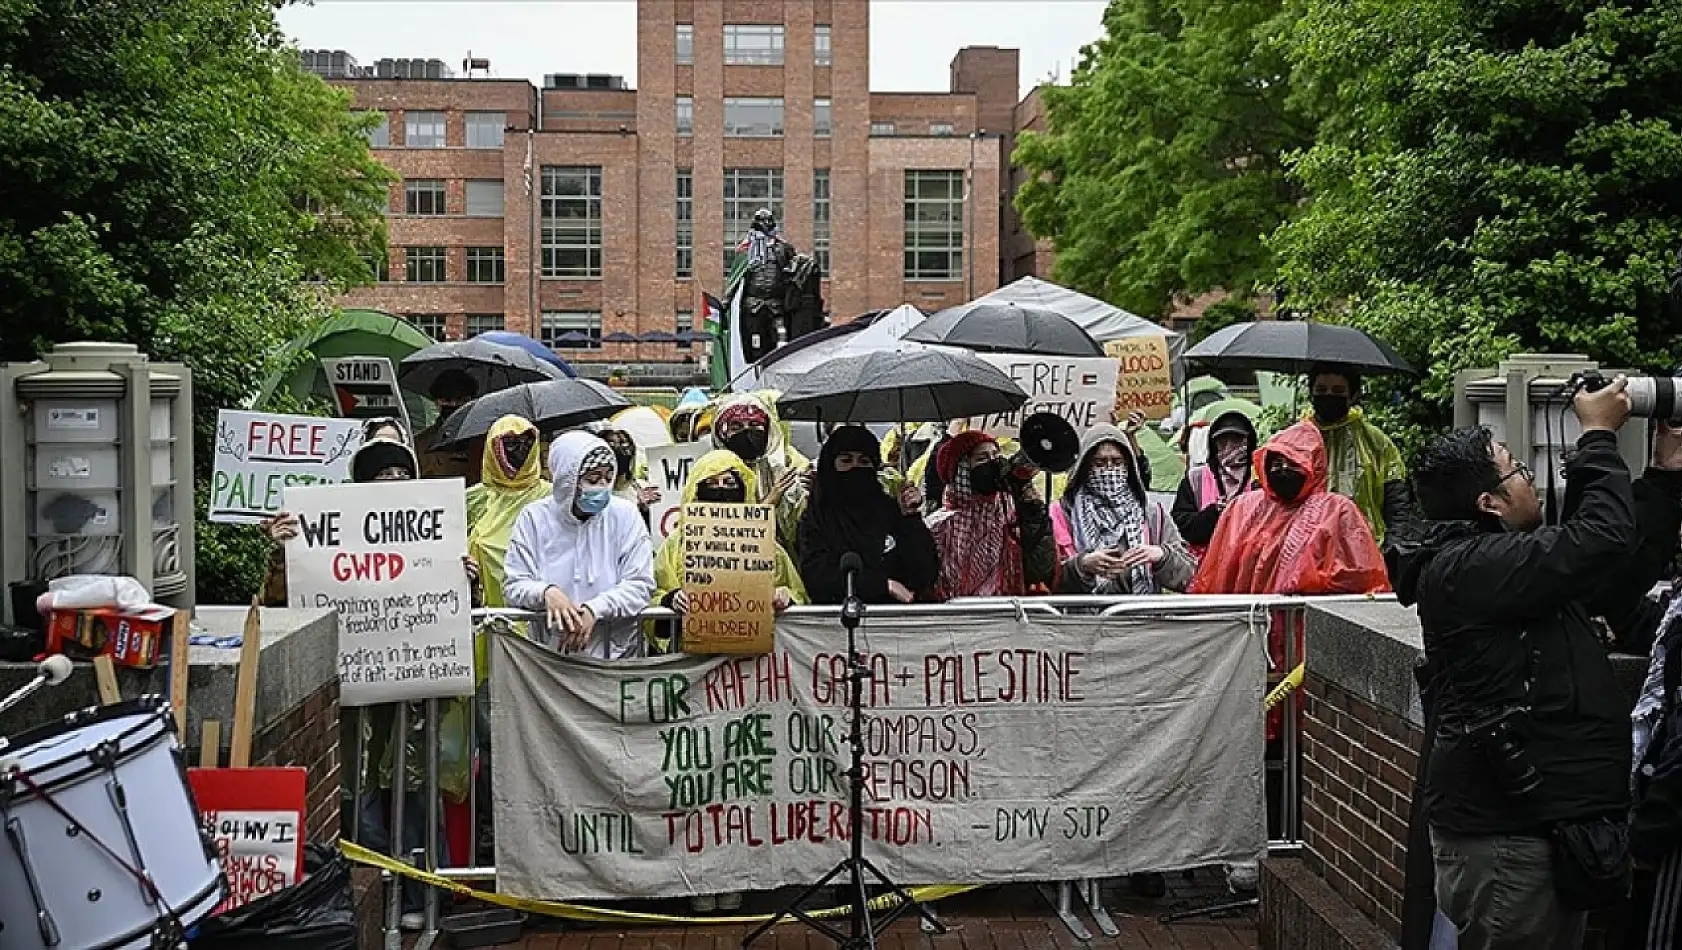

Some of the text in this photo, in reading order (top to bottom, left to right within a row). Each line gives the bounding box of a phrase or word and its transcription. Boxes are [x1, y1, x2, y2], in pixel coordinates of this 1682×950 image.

[336, 362, 381, 381] STAND
[1119, 354, 1164, 374] LOOD
[1010, 362, 1076, 397] FREE
[248, 421, 328, 457] FREE
[687, 506, 773, 521] WE WILL NOT
[299, 508, 445, 548] WE CHARGE
[685, 524, 768, 539] SIT SILENTLY
[685, 540, 700, 552] BY
[332, 552, 405, 582] GWPD
[685, 555, 740, 570] STUDENT
[687, 590, 765, 614] BOMBS ON
[686, 616, 760, 637] CHILDREN
[619, 673, 691, 724] FOR
[812, 651, 890, 707] GAA
[924, 648, 1086, 707] PALESTINE
[659, 726, 713, 772] YOU
[722, 713, 776, 760] ARE
[787, 711, 838, 753] OUR
[664, 758, 977, 810] YOU ARE OUR REASON.
[242, 819, 269, 841] AM
[272, 822, 294, 844] I
[558, 812, 644, 855] UNTIL
[661, 803, 764, 853] TOTAL
[1062, 805, 1112, 840] SJP
